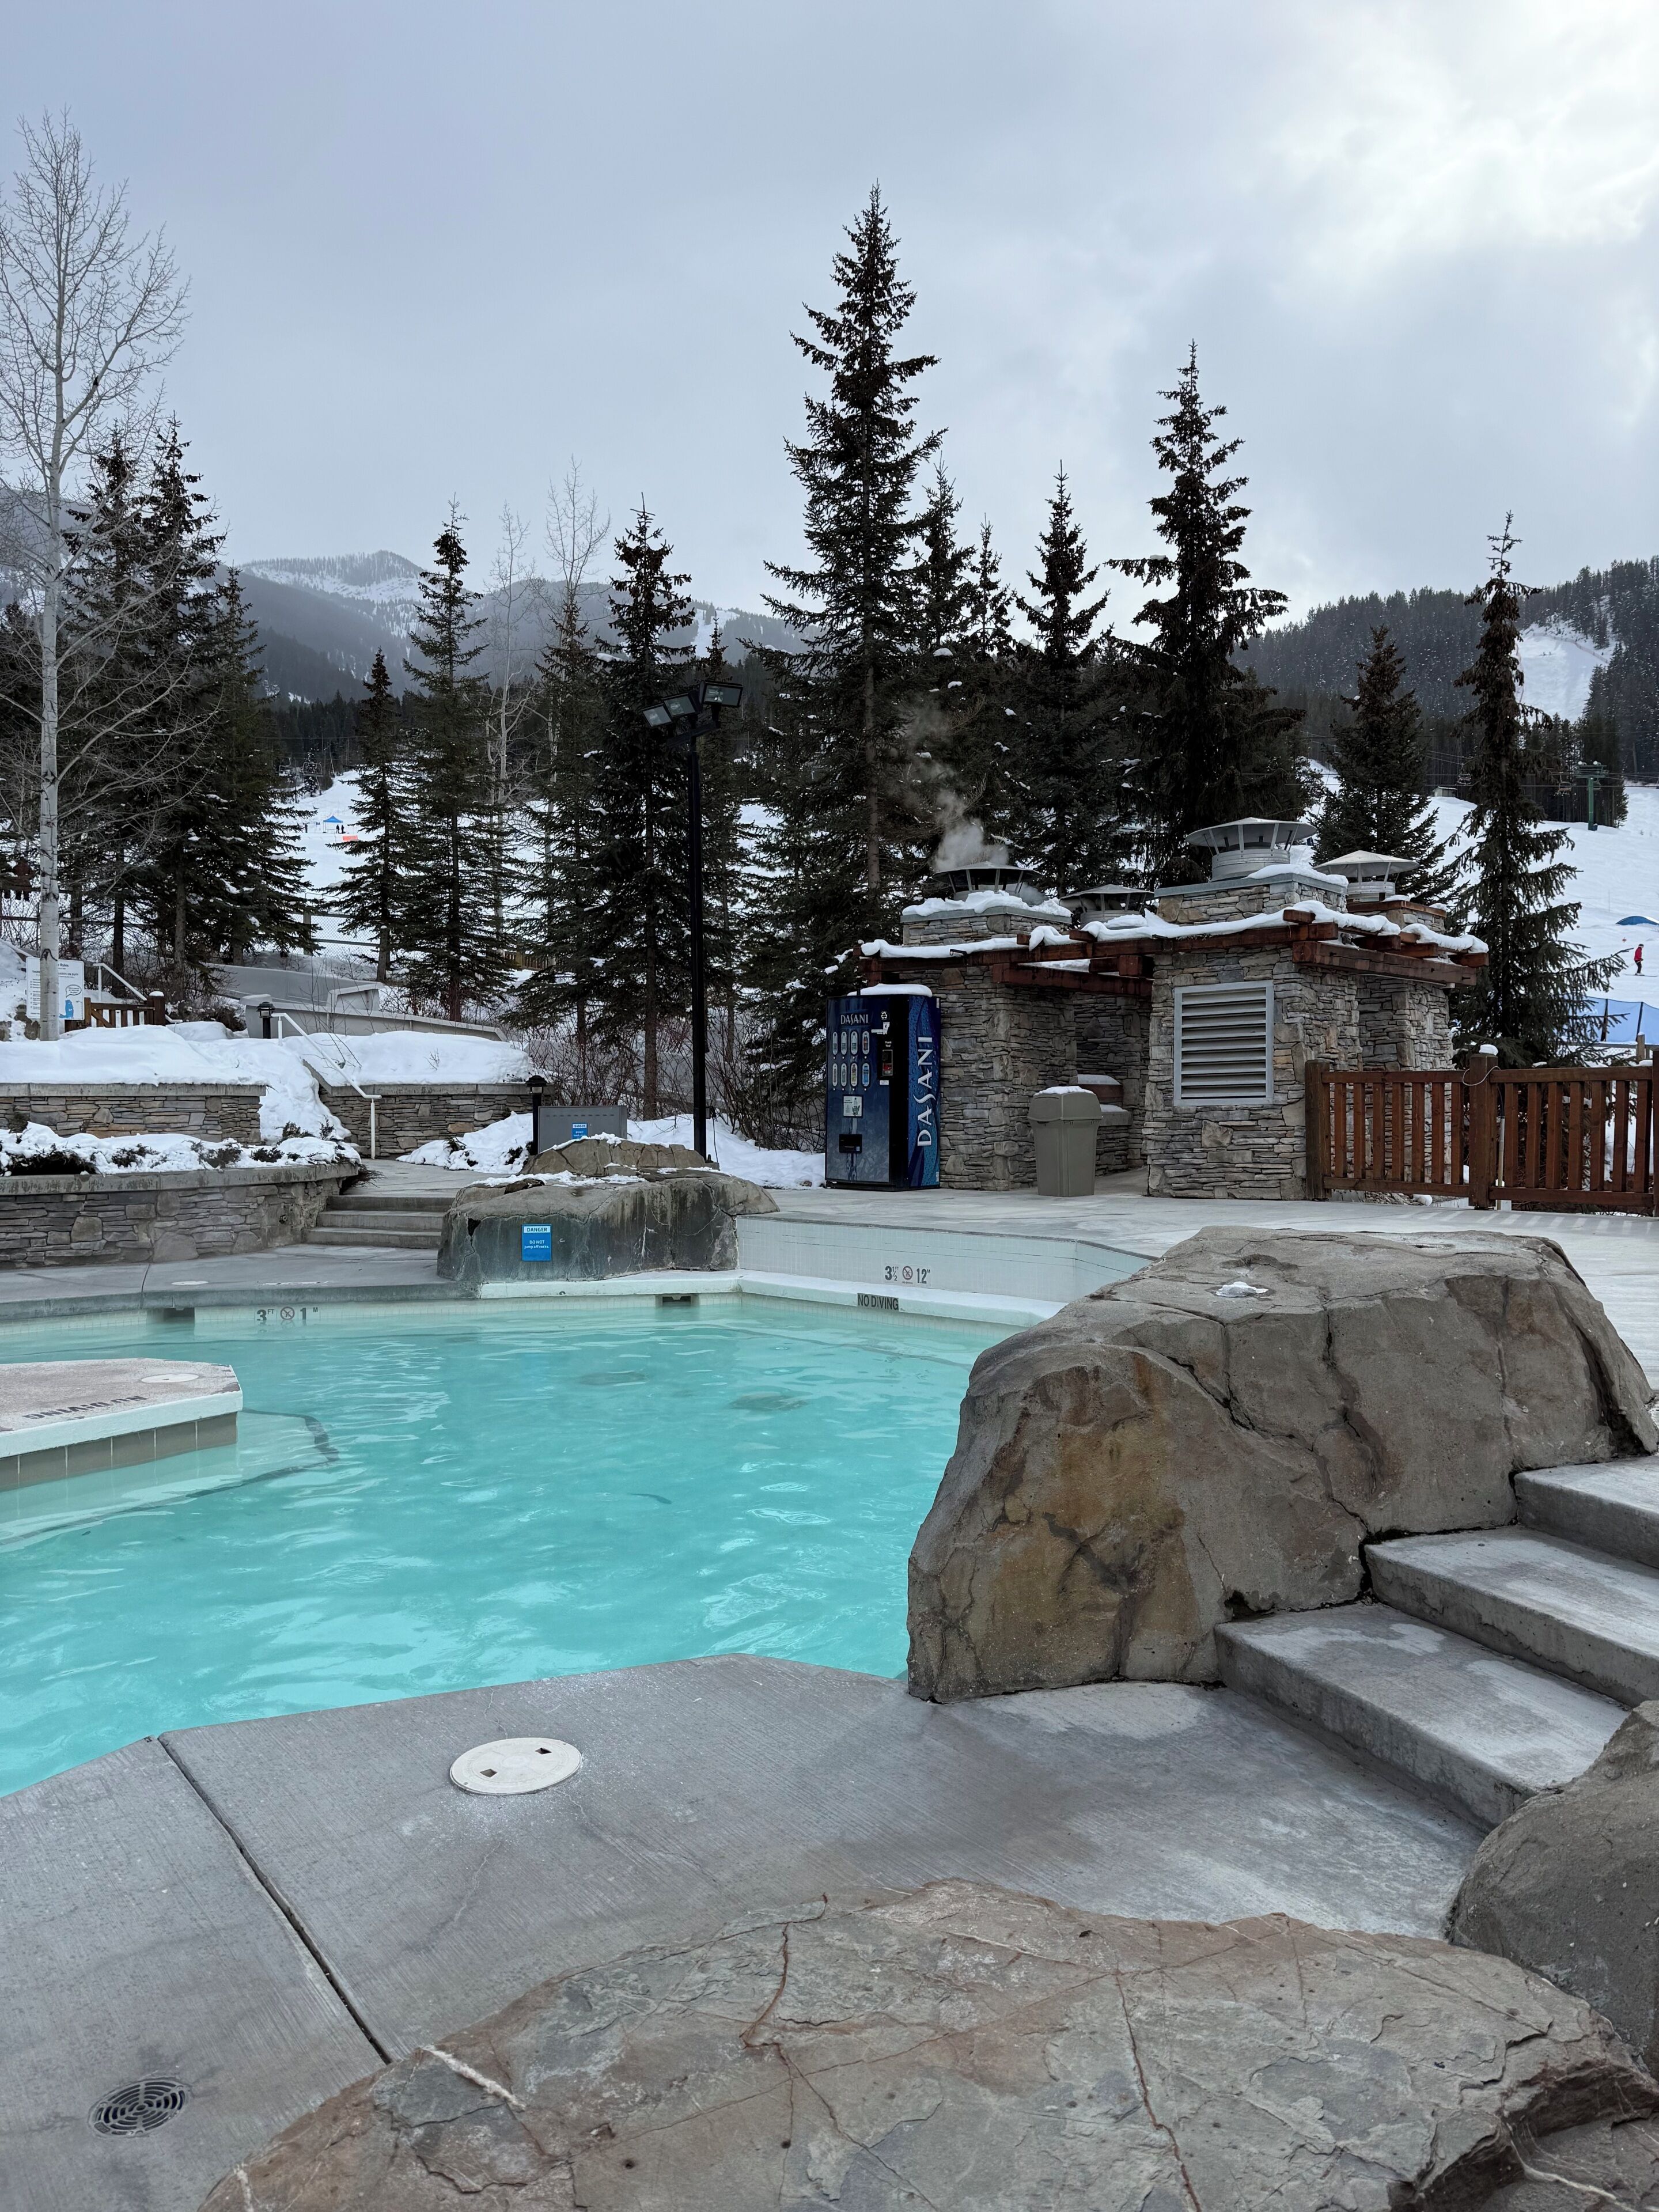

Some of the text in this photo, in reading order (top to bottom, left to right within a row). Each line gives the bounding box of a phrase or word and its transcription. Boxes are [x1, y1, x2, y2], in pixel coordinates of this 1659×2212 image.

[840, 1013, 869, 1025] DASANI
[912, 1037, 936, 1146] DASANI
[858, 1294, 899, 1310] NO DVING
